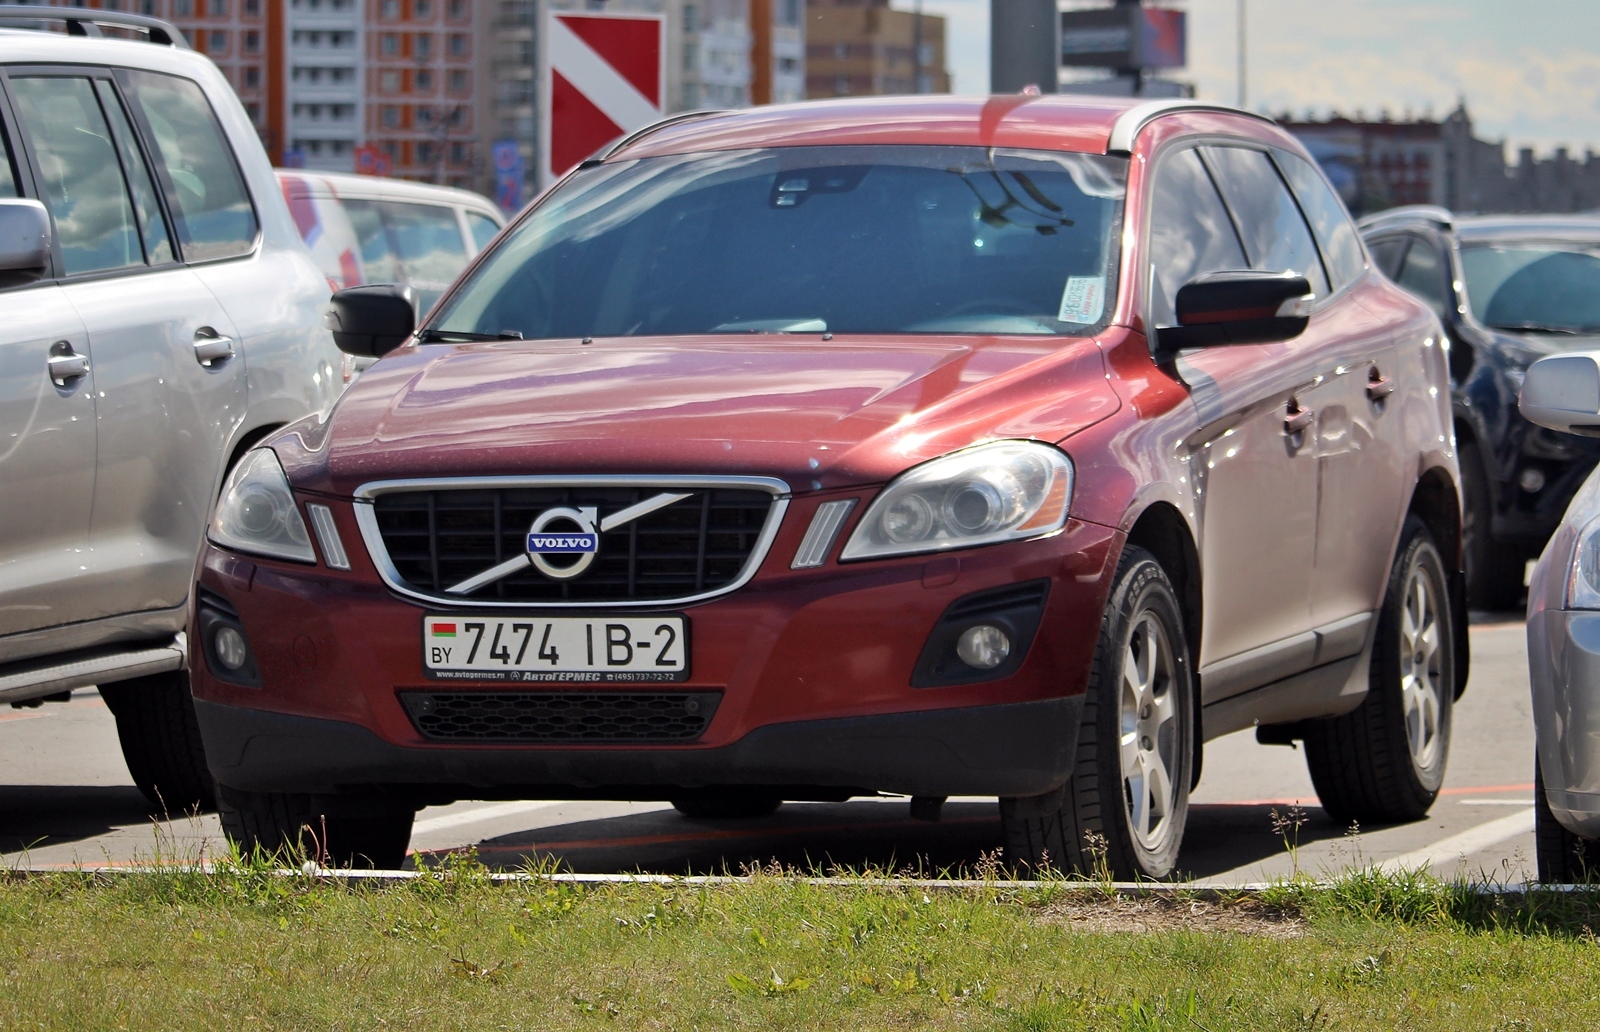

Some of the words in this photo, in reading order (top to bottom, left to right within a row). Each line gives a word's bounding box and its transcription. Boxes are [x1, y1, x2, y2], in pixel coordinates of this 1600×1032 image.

[531, 538, 592, 548] VOLVO
[464, 623, 560, 666] 7474
[586, 624, 678, 666] IB-2
[431, 647, 452, 664] BY
[436, 671, 505, 680] www.avtogermes.ru
[614, 673, 635, 681] (495)
[636, 673, 675, 681] 737-72-72
